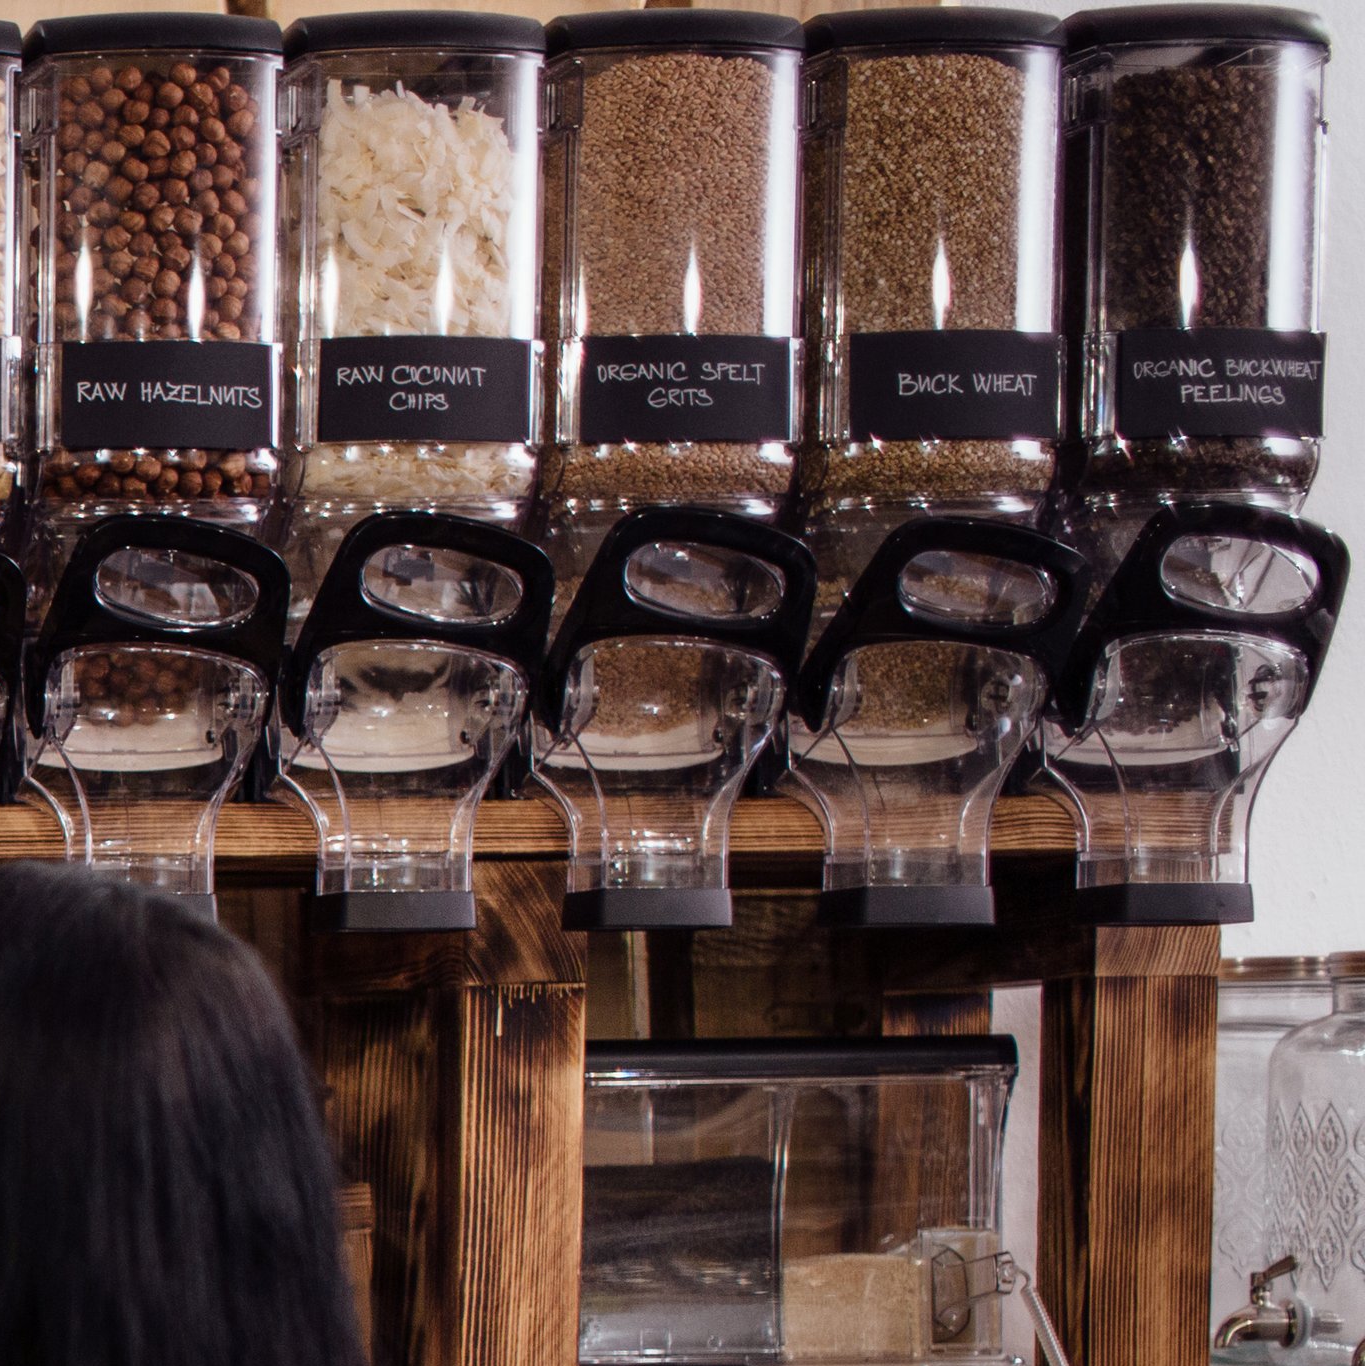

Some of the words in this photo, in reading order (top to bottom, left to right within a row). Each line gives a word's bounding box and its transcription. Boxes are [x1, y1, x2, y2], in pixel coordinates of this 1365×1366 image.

[336, 365, 384, 386] RAW
[391, 365, 487, 388] COCONUT
[596, 361, 688, 383] ORGANIC
[700, 362, 766, 386] SPELT
[1132, 358, 1216, 379] ORGANIC
[1225, 358, 1322, 381] BUCKWHEAT
[76, 381, 127, 403] RAW
[140, 381, 263, 409] HAZELNUTS
[898, 373, 964, 396] BUCK
[972, 373, 1038, 397] WHEAT
[1180, 383, 1286, 406] PEELINGS
[388, 391, 450, 411] CHIPS
[647, 387, 714, 408] GRITS
